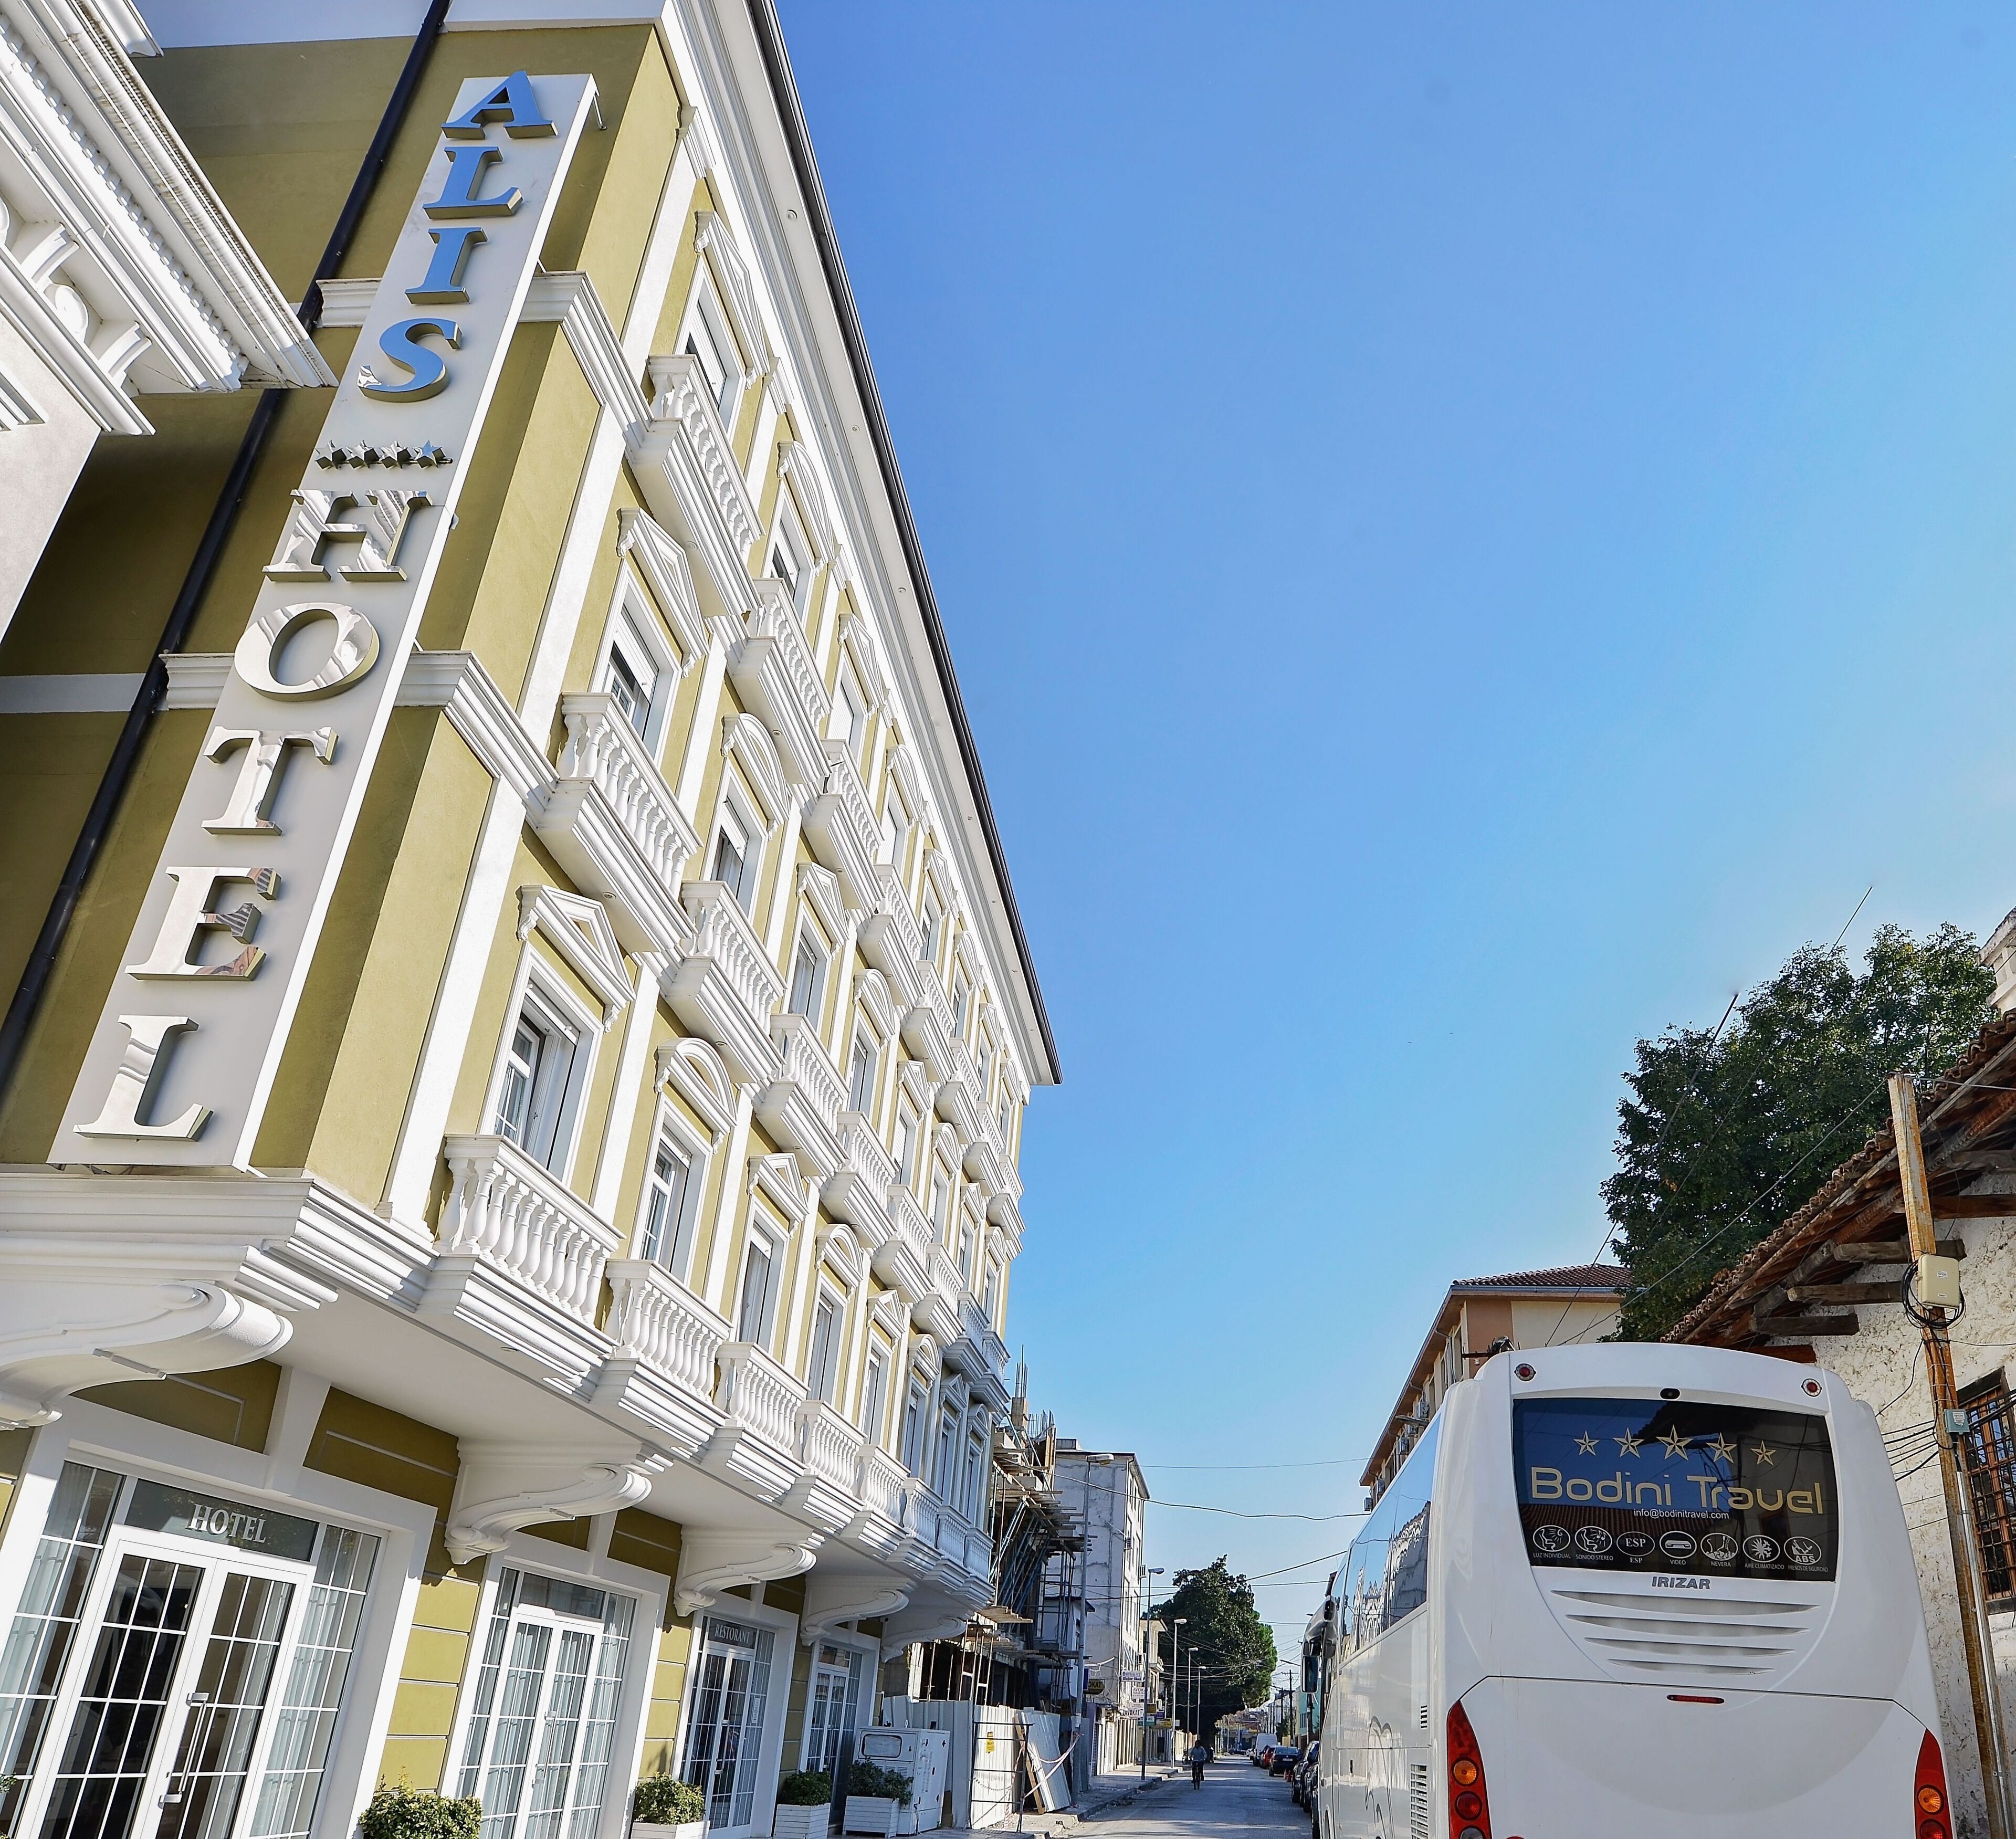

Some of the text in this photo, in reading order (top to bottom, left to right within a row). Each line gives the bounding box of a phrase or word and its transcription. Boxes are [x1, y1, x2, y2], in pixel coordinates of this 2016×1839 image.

[357, 70, 558, 403] ALIS
[74, 489, 433, 1141] HOTEL
[1531, 1467, 1823, 1515] Bodini Travel
[186, 1504, 267, 1543] HOTEL
[1633, 1508, 1729, 1520] info@bodinitravel.com
[1625, 1538, 1646, 1547] ESP
[1652, 1576, 1710, 1589] IRIZAR
[715, 1624, 751, 1644] RESTORANT
